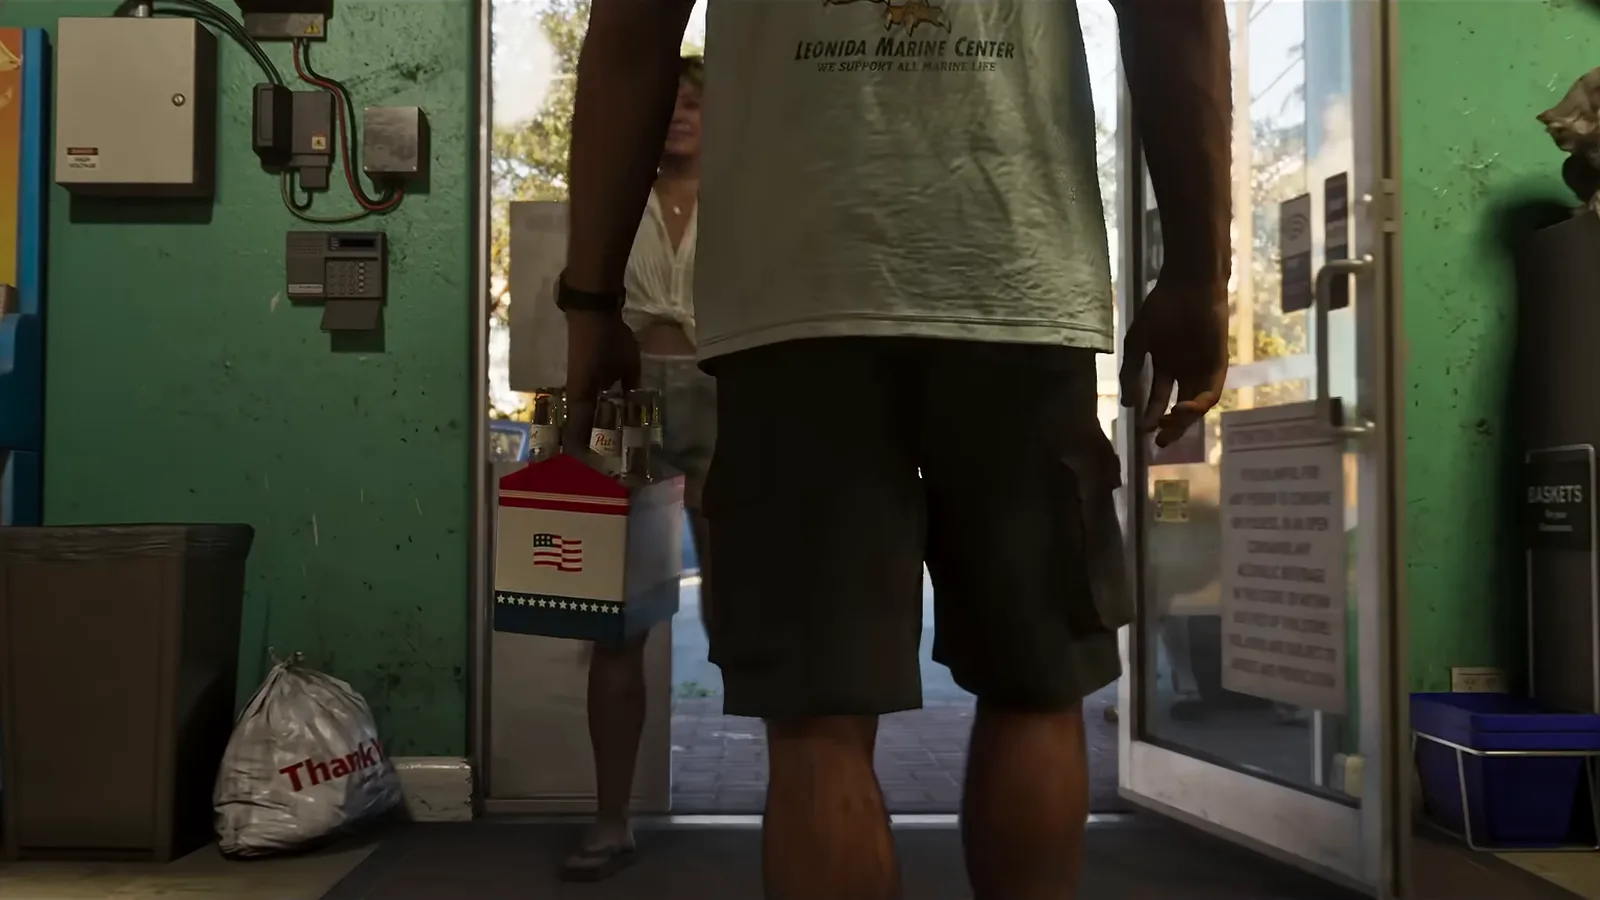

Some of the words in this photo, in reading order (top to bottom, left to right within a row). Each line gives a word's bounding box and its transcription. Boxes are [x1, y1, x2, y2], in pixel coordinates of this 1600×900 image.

[795, 40, 867, 61] LEONIDA
[875, 37, 948, 58] MARINE
[954, 36, 1015, 59] CENTER
[817, 62, 835, 72] WE
[838, 61, 893, 72] SUPPORT
[898, 61, 918, 72] ALL
[922, 61, 968, 72] MARINE
[971, 61, 996, 72] LIFE
[1527, 484, 1583, 503] BASKETS
[279, 741, 376, 792] Thank
